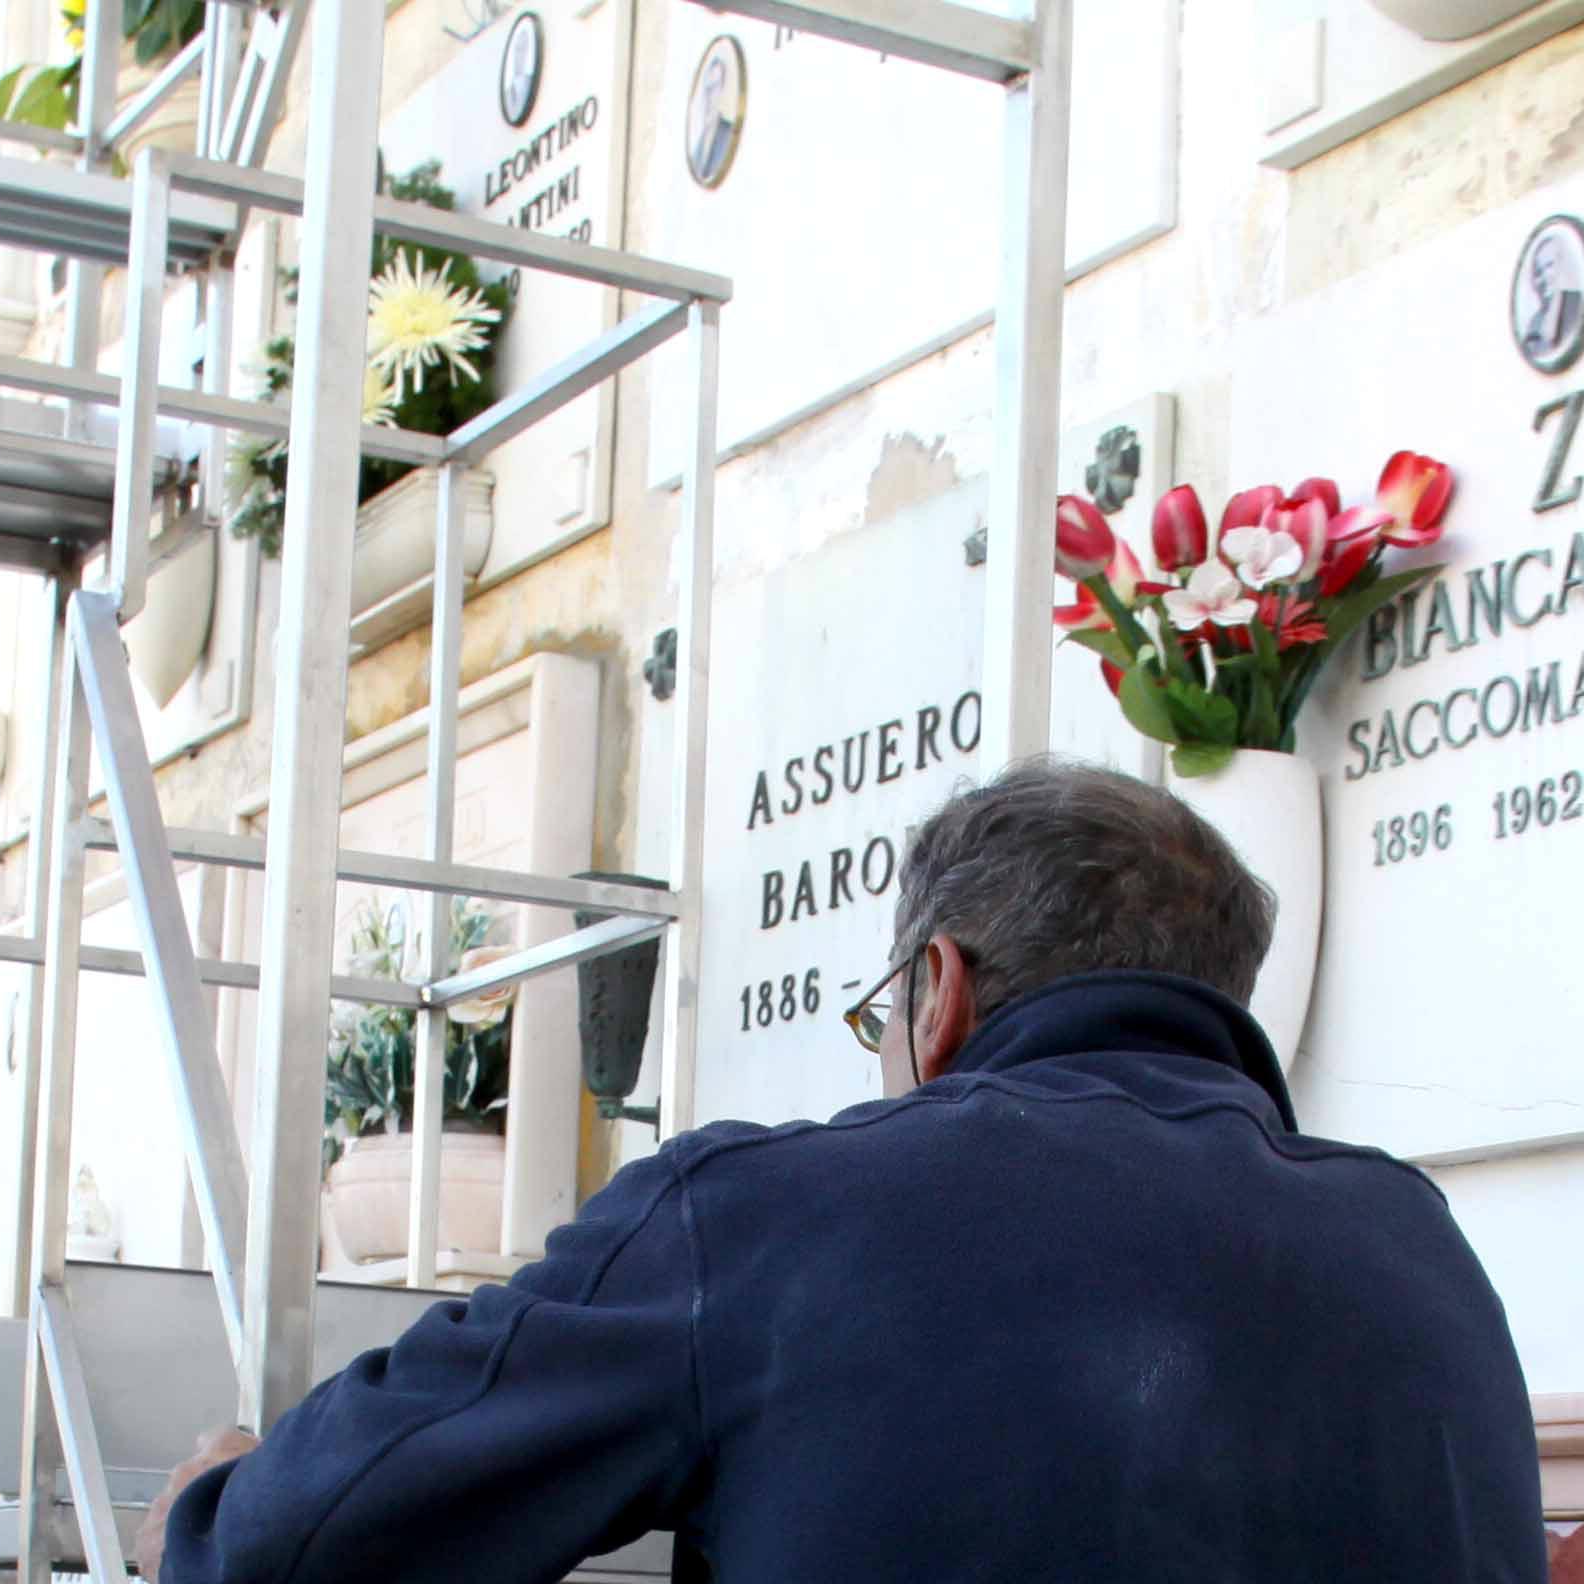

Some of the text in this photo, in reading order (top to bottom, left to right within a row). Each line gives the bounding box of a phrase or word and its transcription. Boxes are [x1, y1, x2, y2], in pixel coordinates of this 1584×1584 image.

[746, 690, 982, 830] ASSUERO
[1372, 769, 1584, 866] 1896 1962
[760, 836, 895, 930] BARO
[739, 967, 822, 1032] 1886
